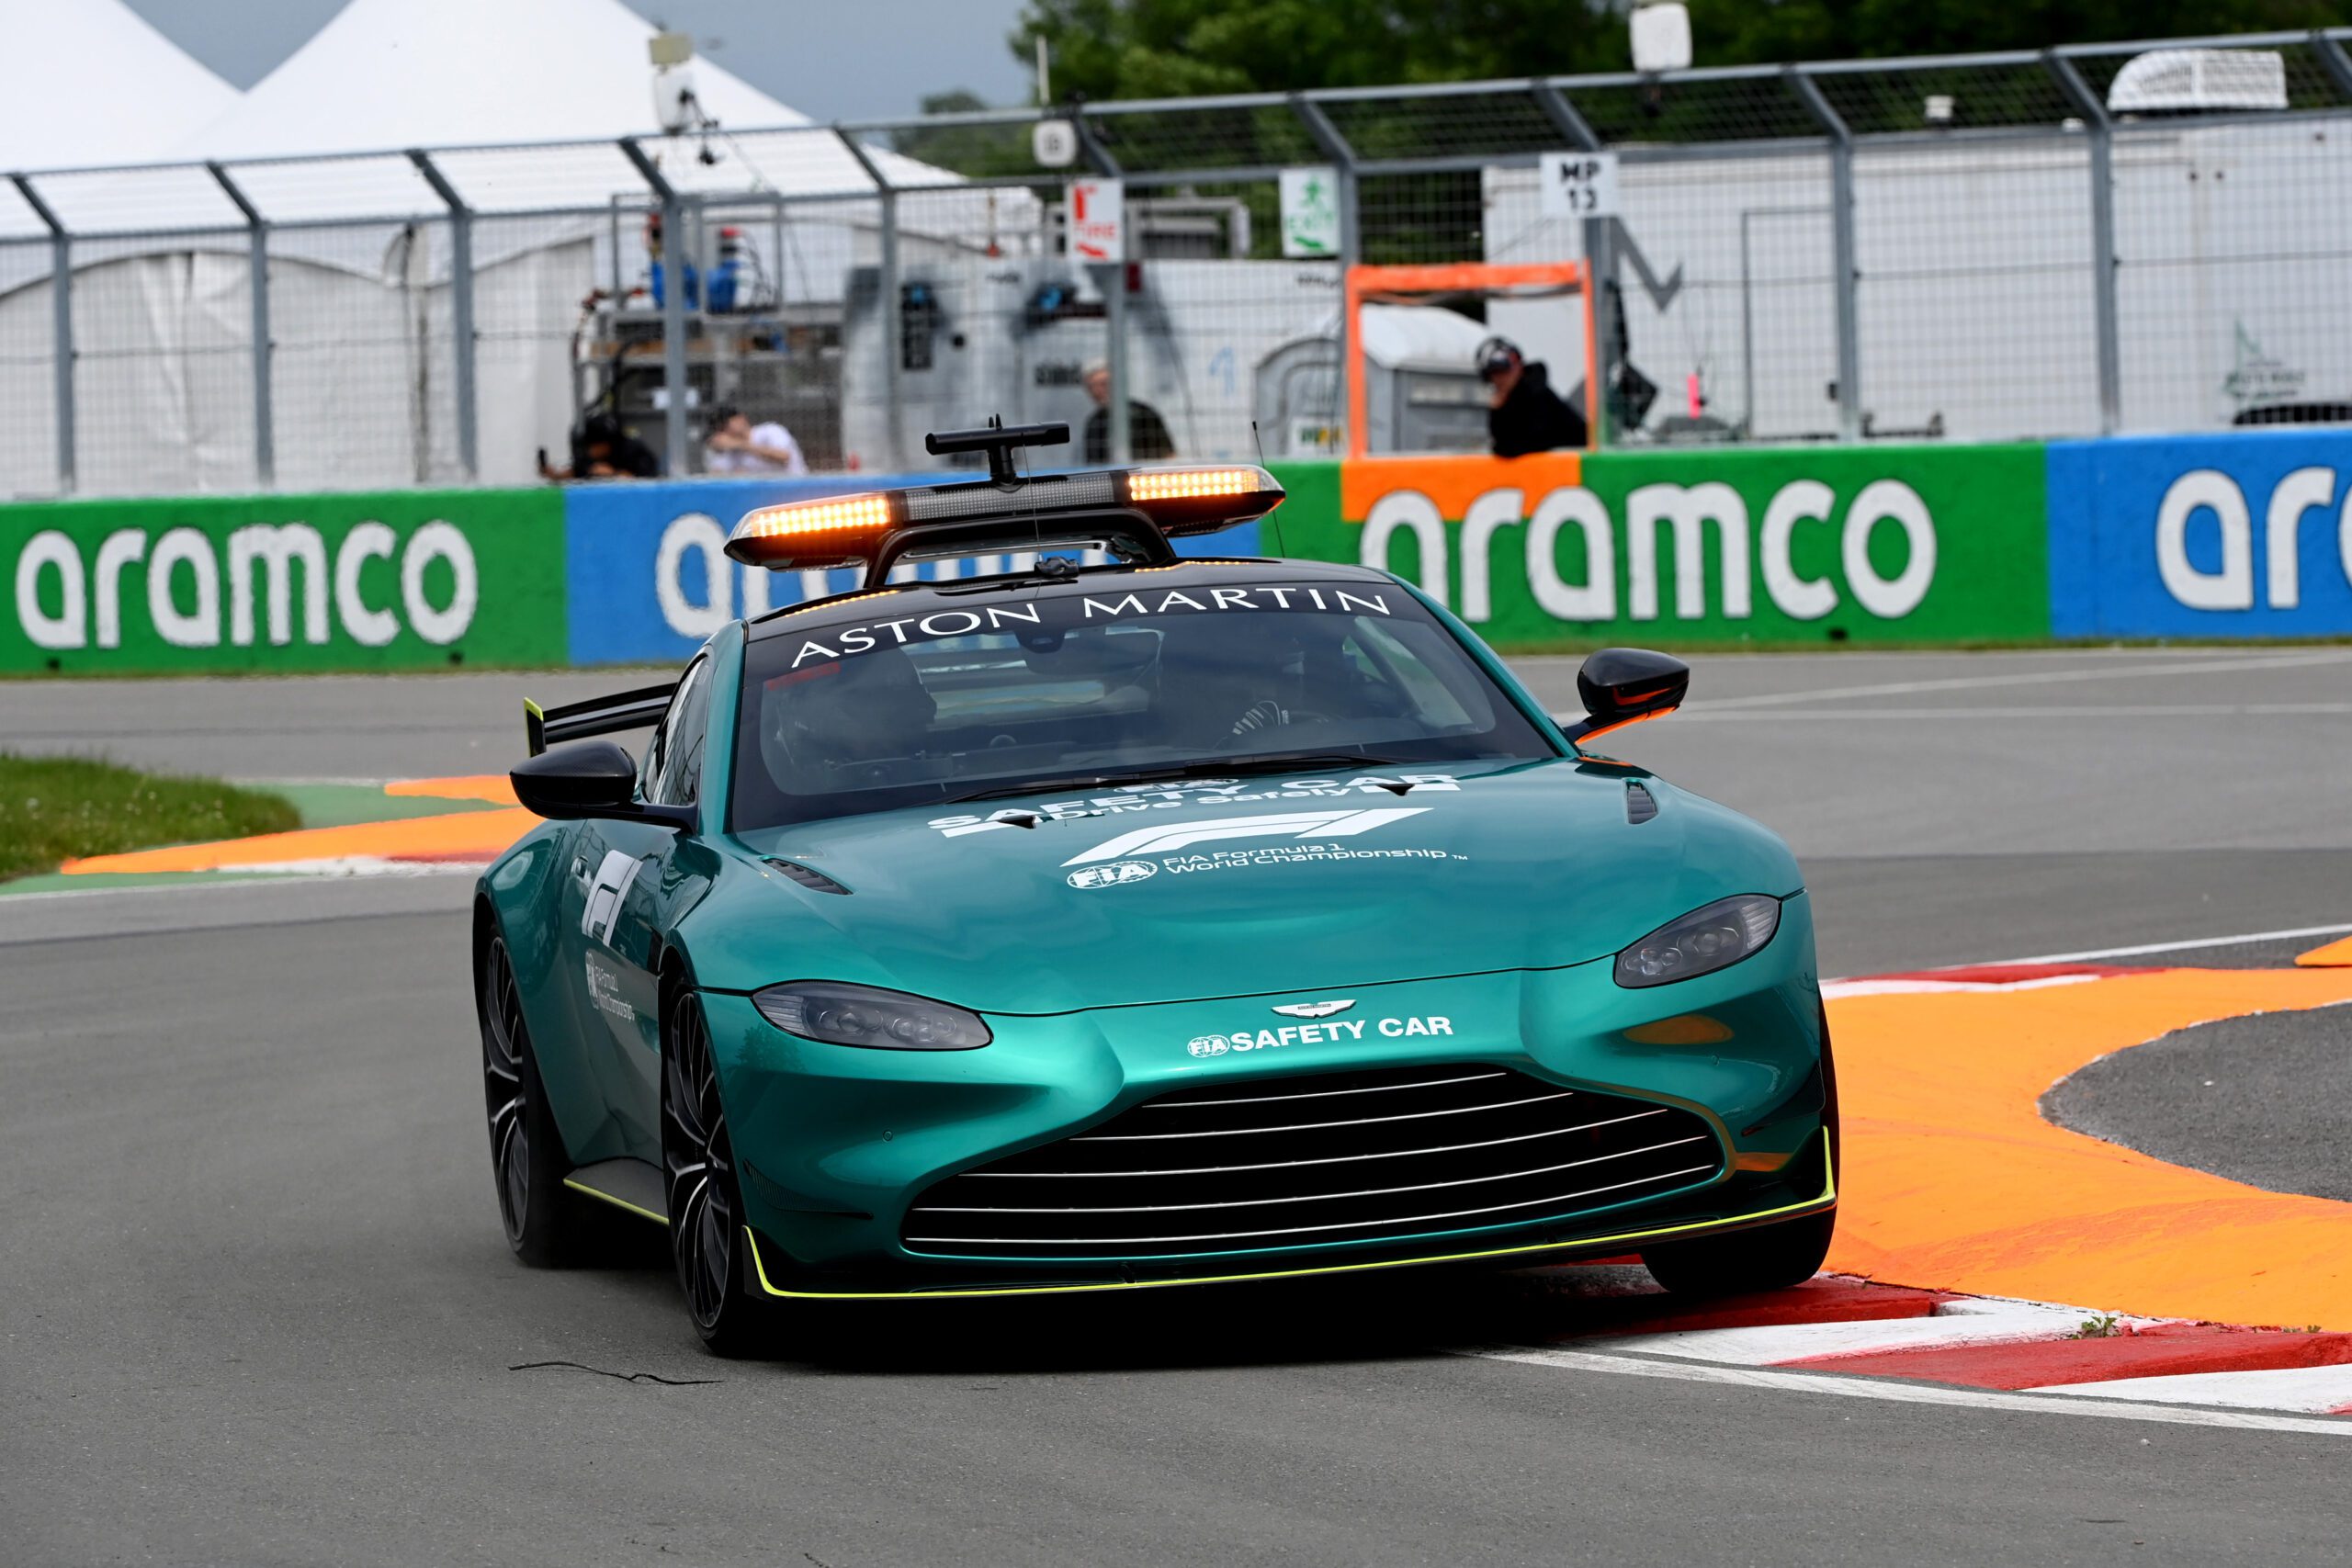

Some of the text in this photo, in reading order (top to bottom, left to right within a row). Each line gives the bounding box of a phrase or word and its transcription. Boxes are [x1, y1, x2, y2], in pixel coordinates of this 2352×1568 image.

[1561, 161, 1600, 185] MP
[1360, 479, 1937, 622] aramco
[16, 520, 478, 649] aramco
[791, 588, 1390, 669] ASTON MARTIN
[928, 774, 1461, 829] SAFETY CAR
[1052, 787, 1351, 820] Drive Safely
[1163, 843, 1345, 866] FIA Formula 1
[1165, 857, 1250, 874] World
[1254, 848, 1447, 865] Championship
[1069, 862, 1154, 889] FIA
[1188, 1016, 1453, 1056] FIA SAFETY CAR
